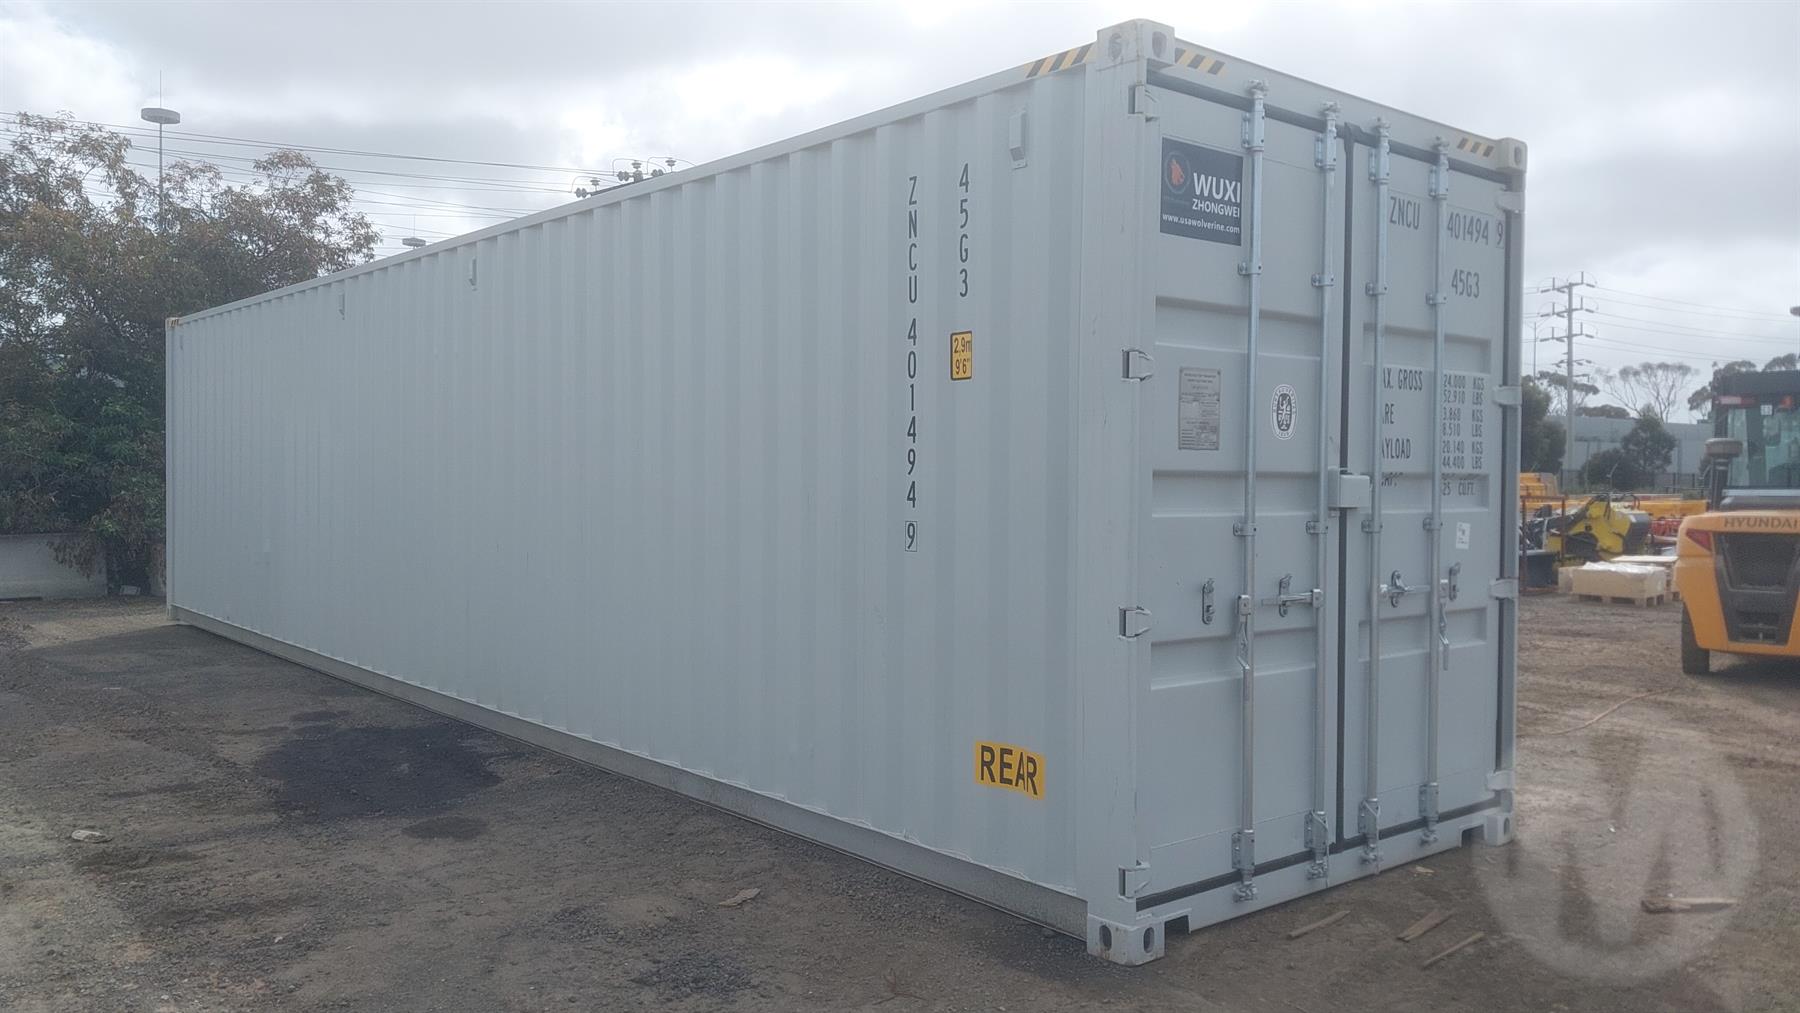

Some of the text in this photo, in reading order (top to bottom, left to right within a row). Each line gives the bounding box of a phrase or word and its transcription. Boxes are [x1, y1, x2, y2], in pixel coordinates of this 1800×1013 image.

[1193, 172, 1241, 203] WUXI
[1162, 213, 1240, 234] www.usawolverine.com
[1192, 198, 1241, 218] ZHONGWEI
[1389, 195, 1504, 246] ZNCU 401494 9
[908, 175, 918, 304] ZNCU
[958, 162, 970, 298] 45G3
[1451, 268, 1481, 299] 45G3
[1398, 367, 1424, 392] GROSS
[906, 317, 918, 509] 401494
[1724, 517, 1799, 529] HYUNDAI
[980, 744, 1038, 796] REAR
